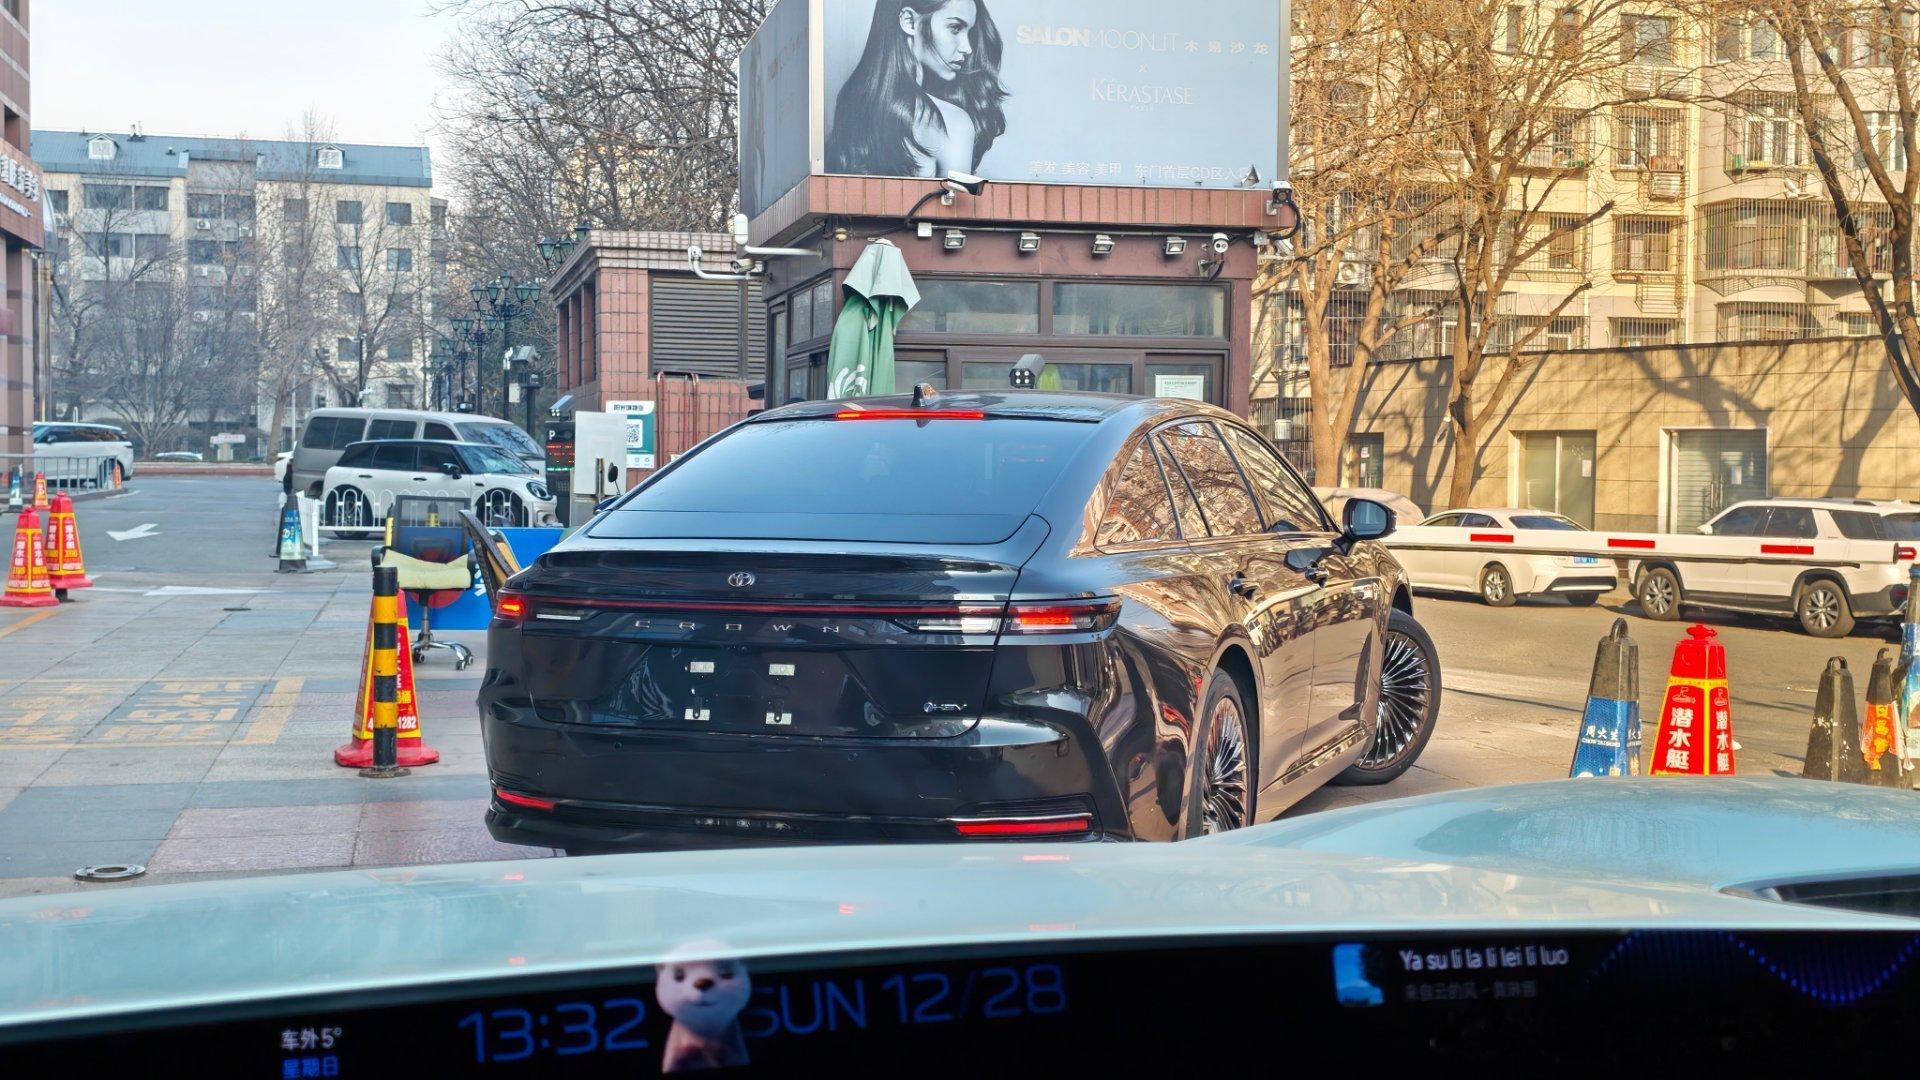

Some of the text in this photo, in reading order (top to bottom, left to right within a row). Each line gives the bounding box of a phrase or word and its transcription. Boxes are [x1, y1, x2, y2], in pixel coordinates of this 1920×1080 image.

[1016, 24, 1090, 48] SALON
[635, 620, 840, 633] CROWN
[1666, 706, 1694, 770] 潜水艇
[1715, 710, 1730, 772] 潜水艇
[1400, 950, 1424, 971] Ya
[1427, 953, 1448, 970] su
[1466, 949, 1482, 969] la
[1501, 947, 1522, 967] lei
[1541, 945, 1569, 966] luo
[458, 964, 1067, 1064] 13:32 SUN 12/28
[283, 1056, 339, 1080] 星期日
